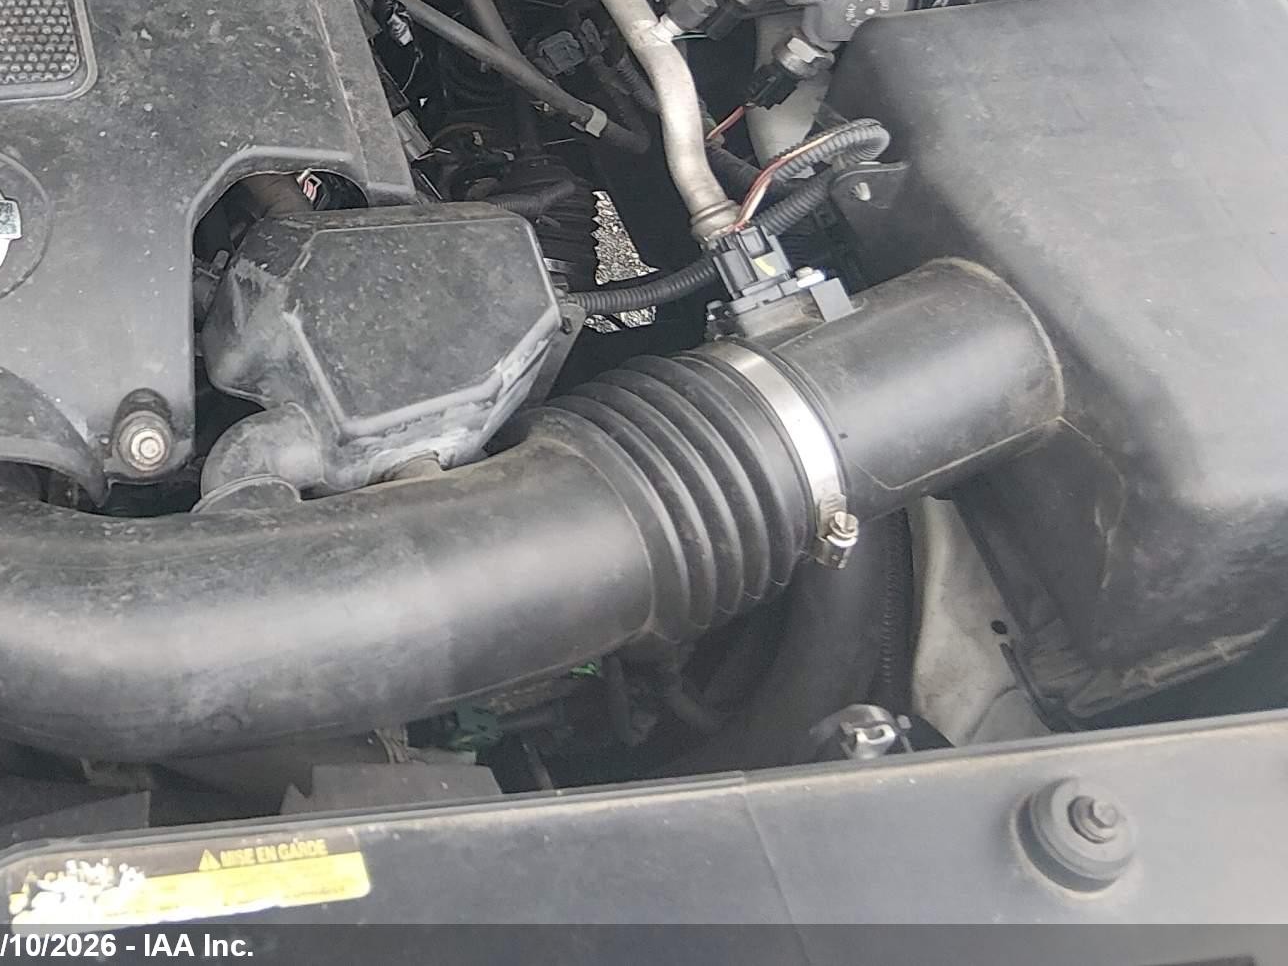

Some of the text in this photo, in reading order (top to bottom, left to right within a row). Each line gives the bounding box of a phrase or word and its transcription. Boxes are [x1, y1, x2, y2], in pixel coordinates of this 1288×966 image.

[220, 838, 328, 867] MISE EN GARDE
